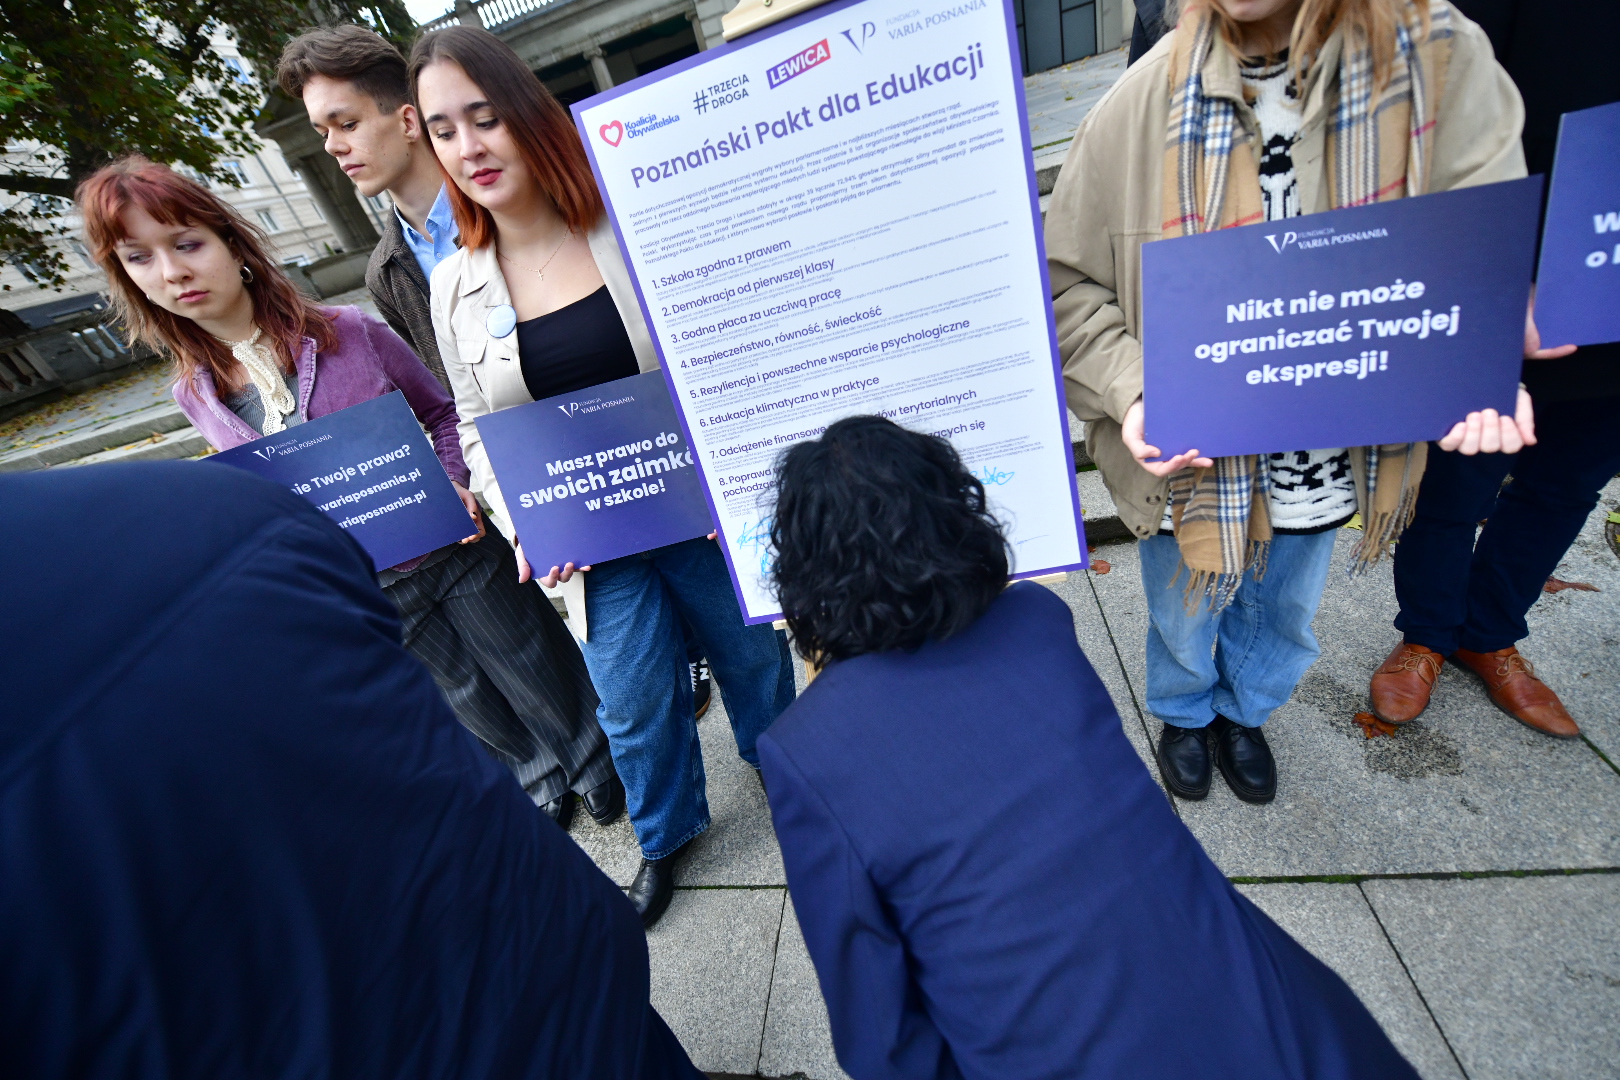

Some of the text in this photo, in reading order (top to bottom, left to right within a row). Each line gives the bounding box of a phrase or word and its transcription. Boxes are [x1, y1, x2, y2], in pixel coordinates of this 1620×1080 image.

[888, 0, 987, 40] VARIA POSNANIA
[770, 44, 828, 85] LEWICA
[624, 114, 657, 130] Koalicja
[630, 42, 983, 188] Poznański Pakt dla Edukacji
[712, 88, 750, 109] DROGA
[628, 114, 680, 138] Obywatelska
[644, 195, 685, 213] dotychczasowej
[685, 187, 707, 199] opozycji
[707, 173, 751, 191] demokratycznej
[750, 166, 773, 176] wygrały
[773, 158, 794, 169] wybory
[795, 143, 838, 163] parlamentarne
[848, 128, 884, 144] najbliższych
[884, 115, 920, 131] miesiącach
[921, 107, 945, 119] stworzą
[945, 101, 963, 111] rząd.
[658, 204, 687, 219] pierwszych
[688, 196, 709, 207] wyzwań
[710, 190, 728, 199] będzie
[730, 182, 752, 193] reforma
[753, 173, 777, 185] systemu
[779, 164, 804, 176] edukacji.
[806, 158, 821, 167] Przez
[823, 150, 847, 162] ostatnie
[865, 132, 900, 148] organizacje
[902, 116, 947, 136] społeczeństwa
[949, 99, 999, 120] obywatelskiego
[668, 214, 682, 222] rzecz
[682, 205, 710, 218] oddolnego
[710, 195, 740, 209] budowania
[741, 181, 781, 198] wspierającego
[781, 172, 806, 185] młodych
[806, 167, 820, 176] ludzi
[821, 160, 845, 172] systemu
[846, 146, 888, 164] powstającego
[888, 134, 922, 149] równolegle
[931, 126, 945, 135] wizji
[945, 118, 971, 130] Ministra
[971, 109, 999, 122] Czarnka.
[659, 137, 1004, 251] Wykorzystując przed powołaniem nowego rządu proponujemy trzem dotychczasowej opozycji podpisanie
[660, 228, 695, 242] Obywatelska,
[696, 221, 714, 230] Trzecia
[715, 216, 732, 225] Droga
[756, 201, 777, 211] zdobyły
[785, 192, 805, 202] okręgu
[814, 182, 835, 192] łącznie
[857, 168, 878, 179] głosów
[880, 156, 914, 171] otrzymując
[915, 151, 929, 160] silny
[931, 142, 956, 154] mandat
[968, 127, 1003, 143] zmieniania
[730, 179, 902, 237] którym wybrani posłowie posłanki pójdą parlamentu.
[1298, 228, 1388, 249] VARIA POSNANIA
[1585, 250, 1608, 268] o
[651, 240, 791, 289] 1. Szkoła zgodna z prawem
[661, 258, 834, 316] 2. Demokracja od pierwszej klasy
[670, 288, 841, 343] 3. Godna płaca za uczciwą pracę
[1226, 278, 1426, 323] Nikt nie może
[680, 305, 882, 368] 4. Bezpieczeństwo, równość, świeckość
[1194, 305, 1461, 364] ograniczać Twojej
[689, 320, 969, 398] 5. Rezyliencja i powszechne wsparcie psychologiczne
[1245, 350, 1389, 386] ekspresji!
[581, 404, 600, 414] VARIA
[602, 396, 635, 409] POSNANIA
[699, 376, 879, 427] 6. Edukacja klimatyczna w praktyce
[708, 450, 718, 459] 7.
[718, 437, 772, 456] Odciążenie
[773, 426, 828, 444] finansowe
[898, 390, 977, 414] terytorialnych
[278, 446, 299, 456] VARIA
[298, 434, 332, 450] POSNANIA
[310, 466, 356, 488] Twoje
[357, 444, 411, 476] prawa?
[546, 432, 679, 476] Masz prawo do
[718, 478, 728, 486] 8.
[728, 468, 772, 484] Poprawa
[970, 420, 986, 430] się
[316, 468, 422, 512] variaposnania.pl
[519, 471, 606, 508] swoich
[584, 478, 666, 511] w szkole!
